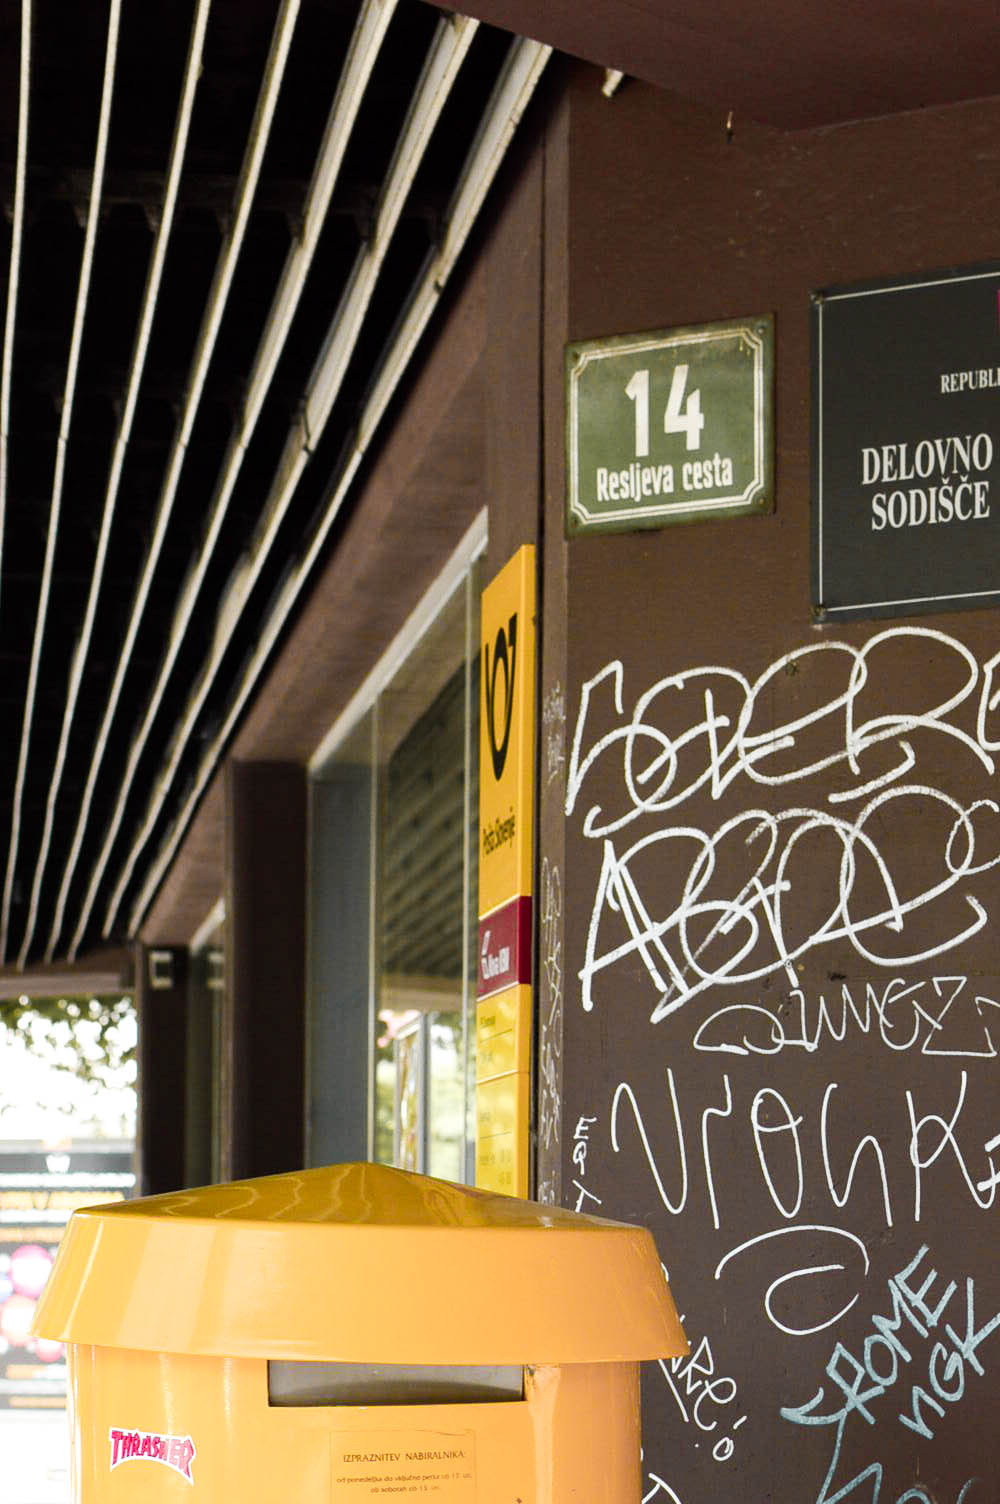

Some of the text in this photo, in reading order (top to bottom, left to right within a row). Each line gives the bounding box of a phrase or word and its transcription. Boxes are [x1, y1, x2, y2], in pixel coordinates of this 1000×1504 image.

[625, 364, 704, 457] 14
[596, 452, 733, 502] Resljeva cesta
[861, 433, 993, 485] DELOVNO
[871, 474, 990, 530] SODIŠČE
[111, 1430, 194, 1478] THRASHER
[343, 1453, 401, 1462] IZPRAZNITEV
